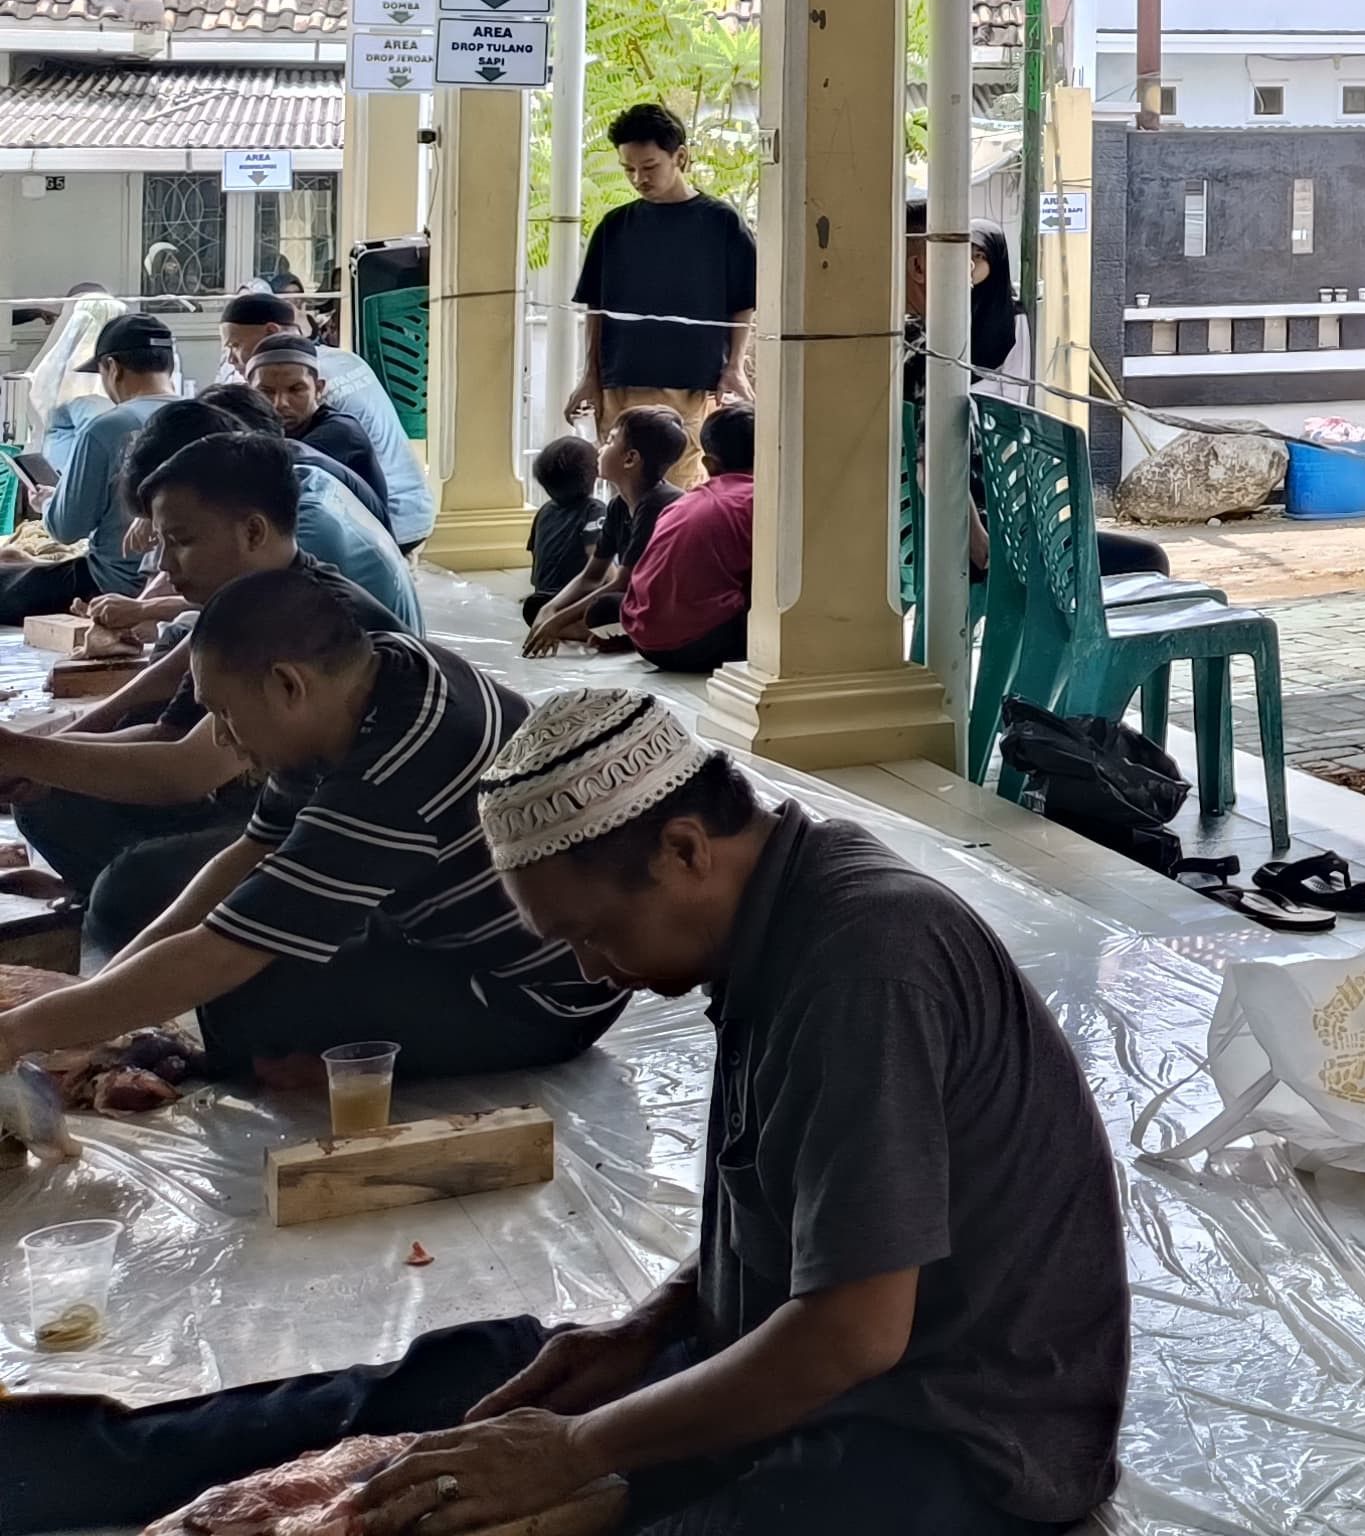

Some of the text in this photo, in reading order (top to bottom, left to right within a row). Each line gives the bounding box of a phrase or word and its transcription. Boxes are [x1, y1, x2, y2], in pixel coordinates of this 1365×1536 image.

[382, 1, 420, 11] DOMBA
[473, 26, 513, 39] AREA
[384, 40, 419, 51] AREA
[451, 42, 484, 52] DROP
[366, 54, 394, 63] DROP
[478, 57, 505, 67] SAPI
[388, 66, 412, 75] SAPI
[245, 153, 271, 161] AREA
